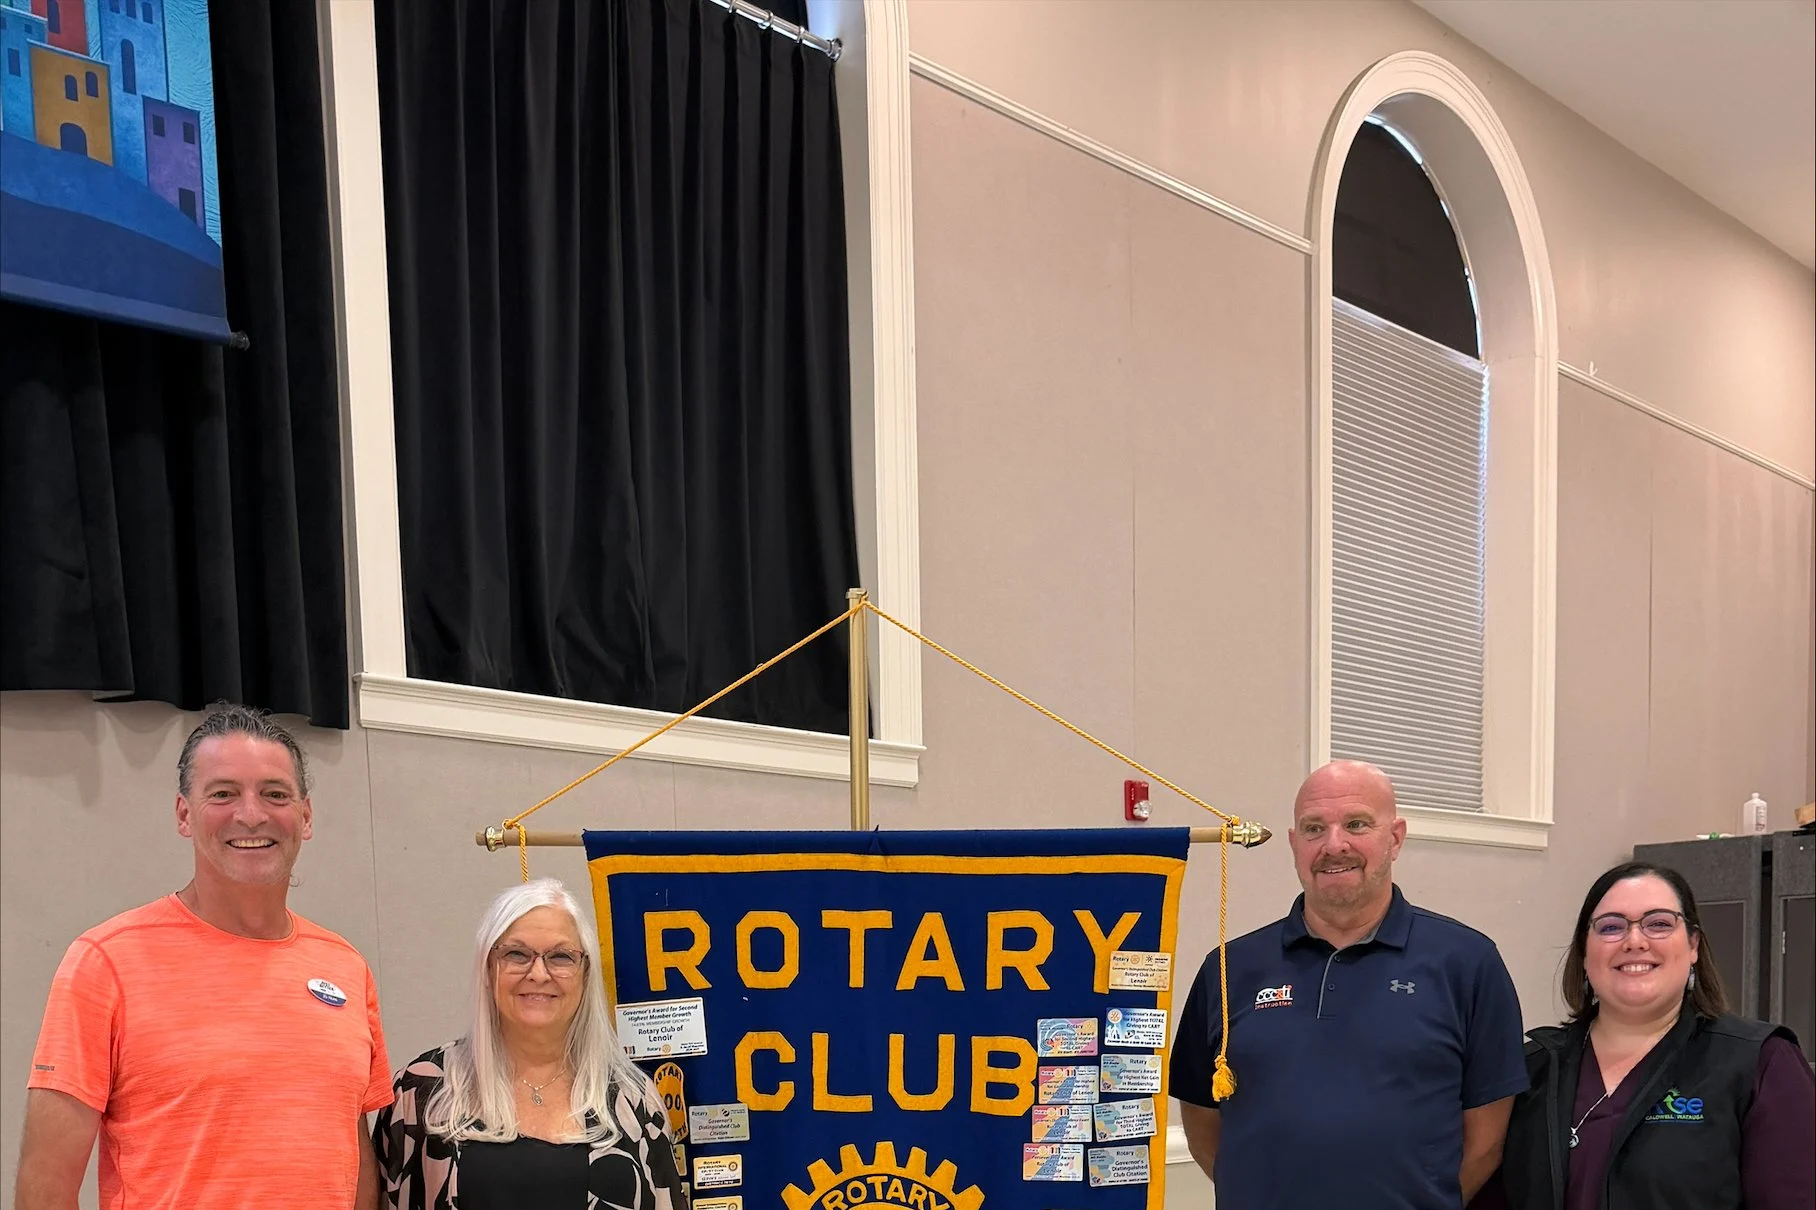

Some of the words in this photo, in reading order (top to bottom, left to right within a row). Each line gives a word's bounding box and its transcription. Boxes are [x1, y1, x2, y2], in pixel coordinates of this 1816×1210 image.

[643, 909, 1141, 994] ROTARY
[623, 1008, 651, 1016] Governor's
[649, 1034, 673, 1042] Lenoir
[734, 1031, 1039, 1116] CLUB
